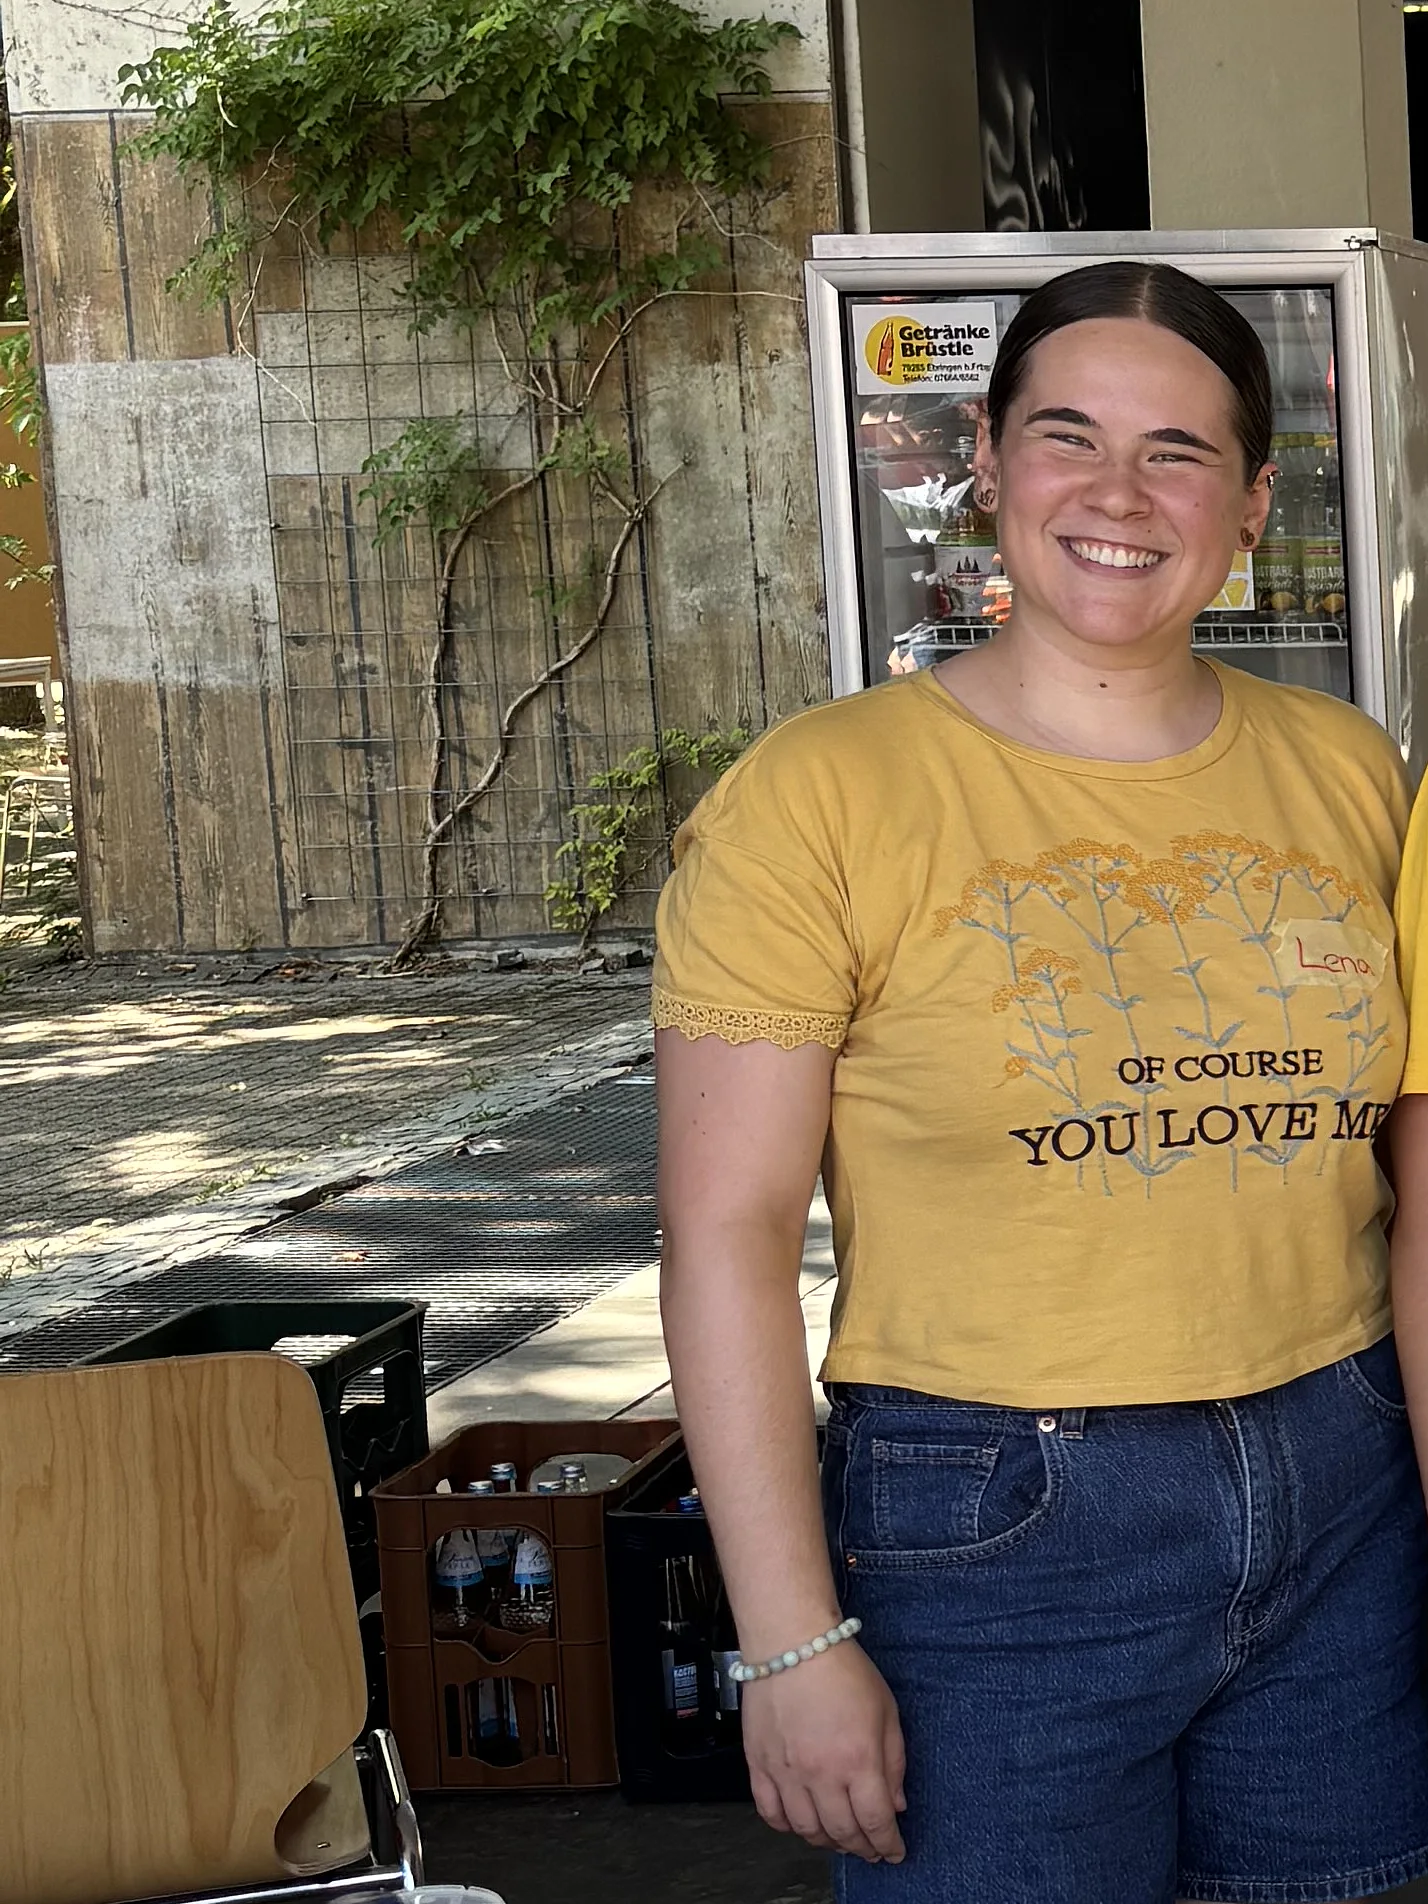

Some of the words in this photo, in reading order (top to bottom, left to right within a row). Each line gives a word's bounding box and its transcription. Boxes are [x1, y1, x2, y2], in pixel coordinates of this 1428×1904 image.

[899, 324, 990, 340] Getränke
[901, 341, 974, 357] Brüstle
[1295, 935, 1375, 976] Lena
[1117, 1056, 1165, 1085] OF
[1174, 1049, 1324, 1082] COURSE
[1009, 1112, 1141, 1166] YOU
[1158, 1100, 1318, 1149] LOVE
